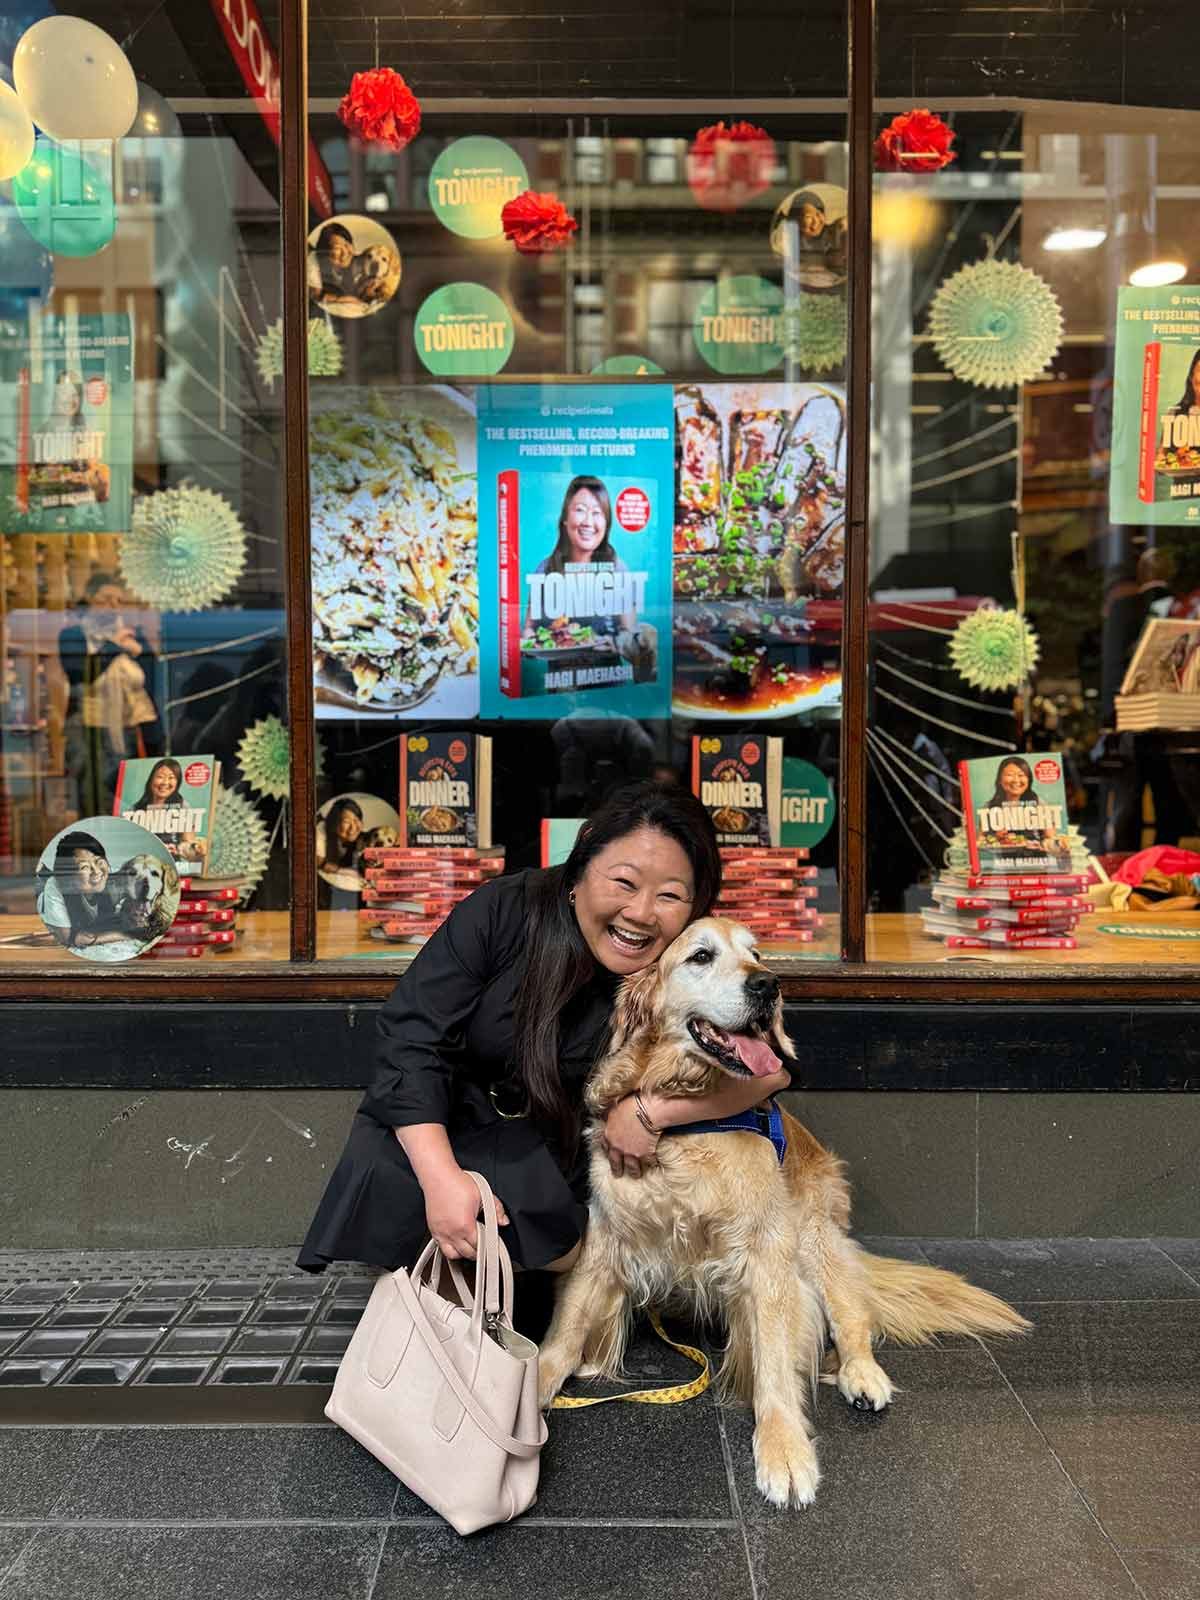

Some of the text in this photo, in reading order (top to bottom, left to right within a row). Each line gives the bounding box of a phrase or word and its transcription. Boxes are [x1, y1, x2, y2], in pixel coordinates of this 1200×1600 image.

[435, 176, 522, 206] TONIGHT
[420, 321, 506, 352] TONIGHT
[703, 315, 775, 343] TONIGH
[485, 427, 505, 440] THE
[507, 427, 576, 440] BESTSELLING,
[1160, 413, 1200, 448] TON
[32, 430, 105, 463] TONIGHT
[519, 443, 636, 457] PHENOMENON RETURNS
[526, 571, 649, 620] TONIGHT
[543, 664, 634, 689] NAGI MAEHASHI
[408, 780, 470, 807] DINNER
[701, 780, 763, 808] DINNER
[782, 796, 828, 823] IGHT
[977, 805, 1062, 831] TONIGHT
